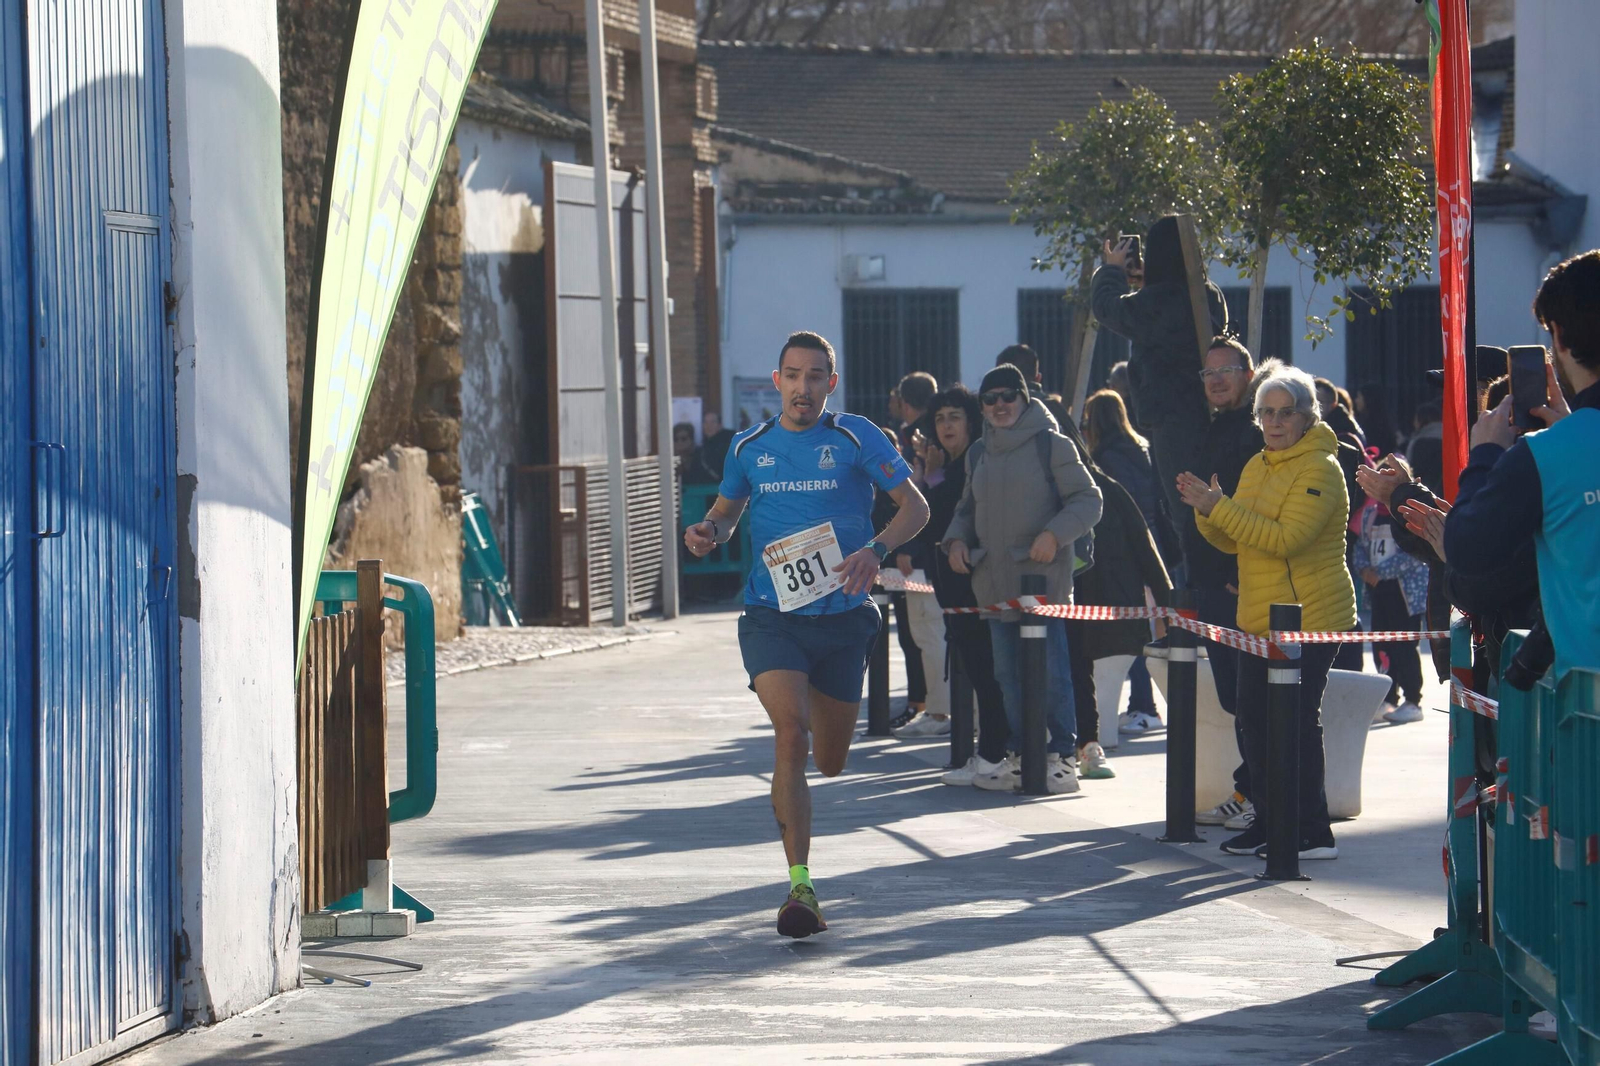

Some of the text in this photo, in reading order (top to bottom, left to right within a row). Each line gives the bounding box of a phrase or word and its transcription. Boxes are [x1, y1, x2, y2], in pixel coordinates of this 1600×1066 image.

[759, 479, 838, 494] TROTASIERRA
[764, 542, 788, 568] XLI
[782, 550, 829, 593] 381
